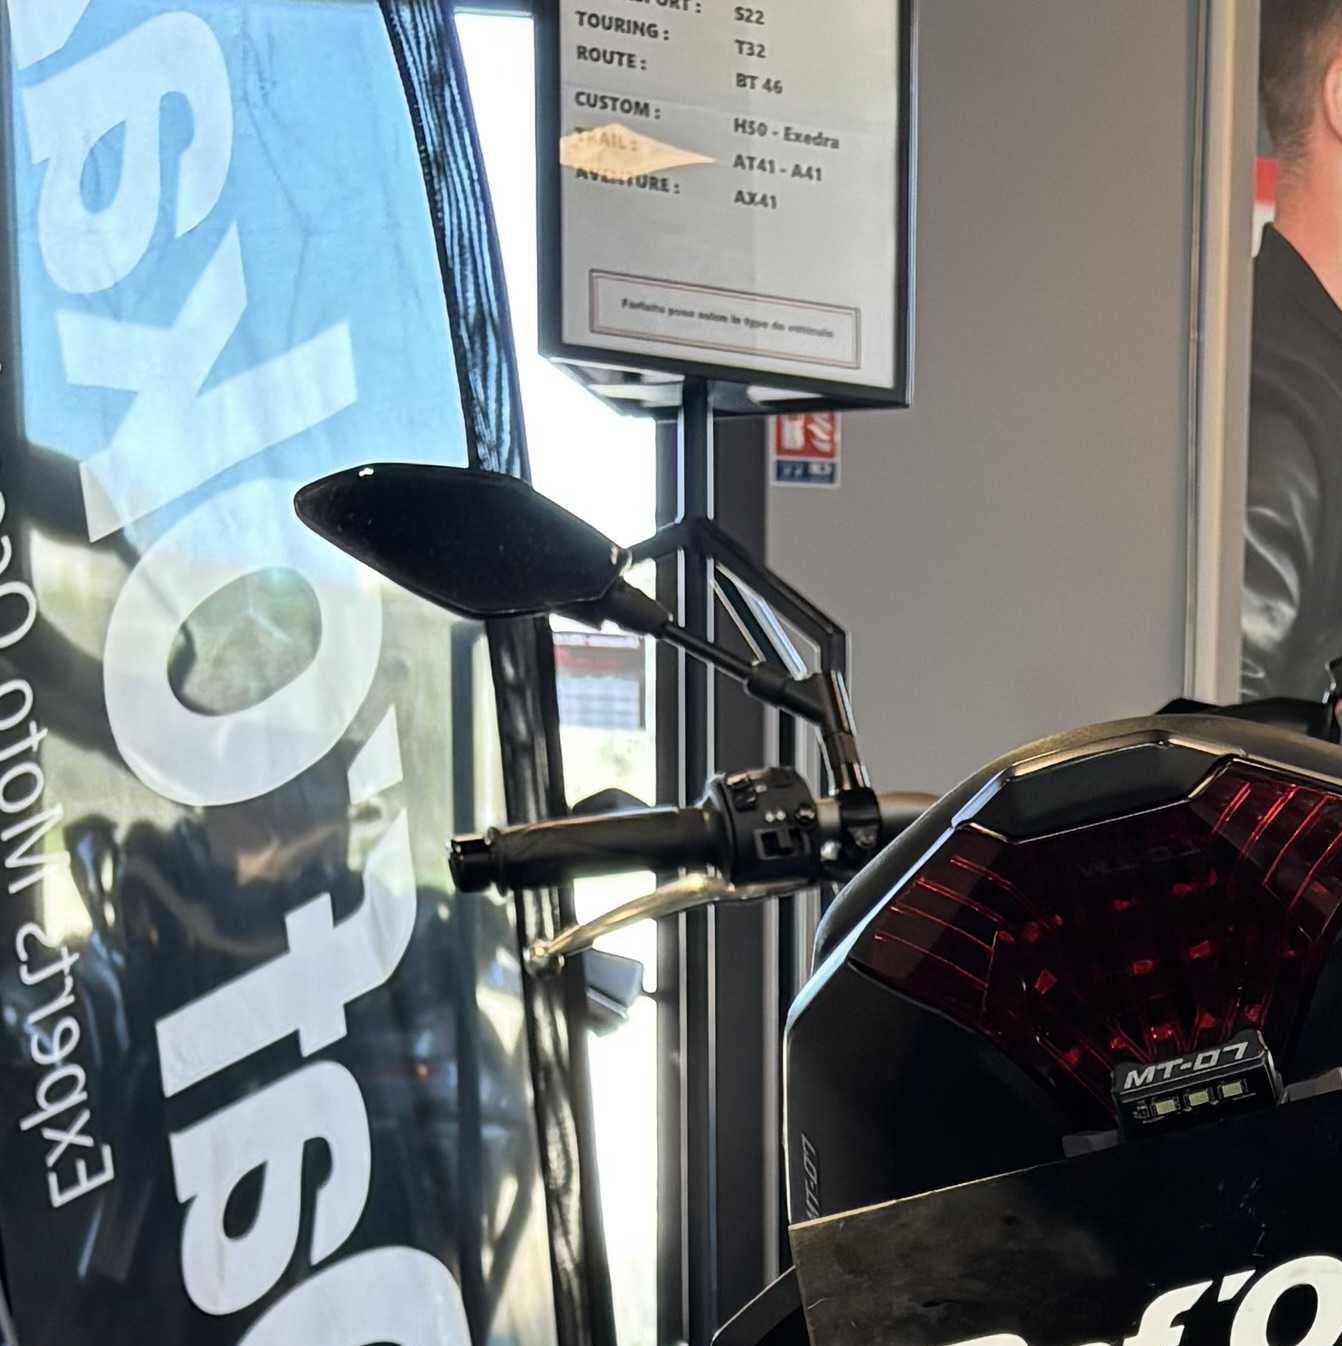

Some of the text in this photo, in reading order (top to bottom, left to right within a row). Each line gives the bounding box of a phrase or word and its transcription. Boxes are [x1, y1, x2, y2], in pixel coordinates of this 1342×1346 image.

[575, 10, 658, 40] TOURING
[734, 6, 765, 25] S22
[576, 45, 637, 69] ROUTE
[734, 39, 766, 59] T32
[735, 72, 758, 90] BT
[574, 91, 650, 118] CUSTOM
[734, 117, 768, 137] H50
[783, 125, 840, 150] Exedra
[1123, 1041, 1249, 1090] MT-07
